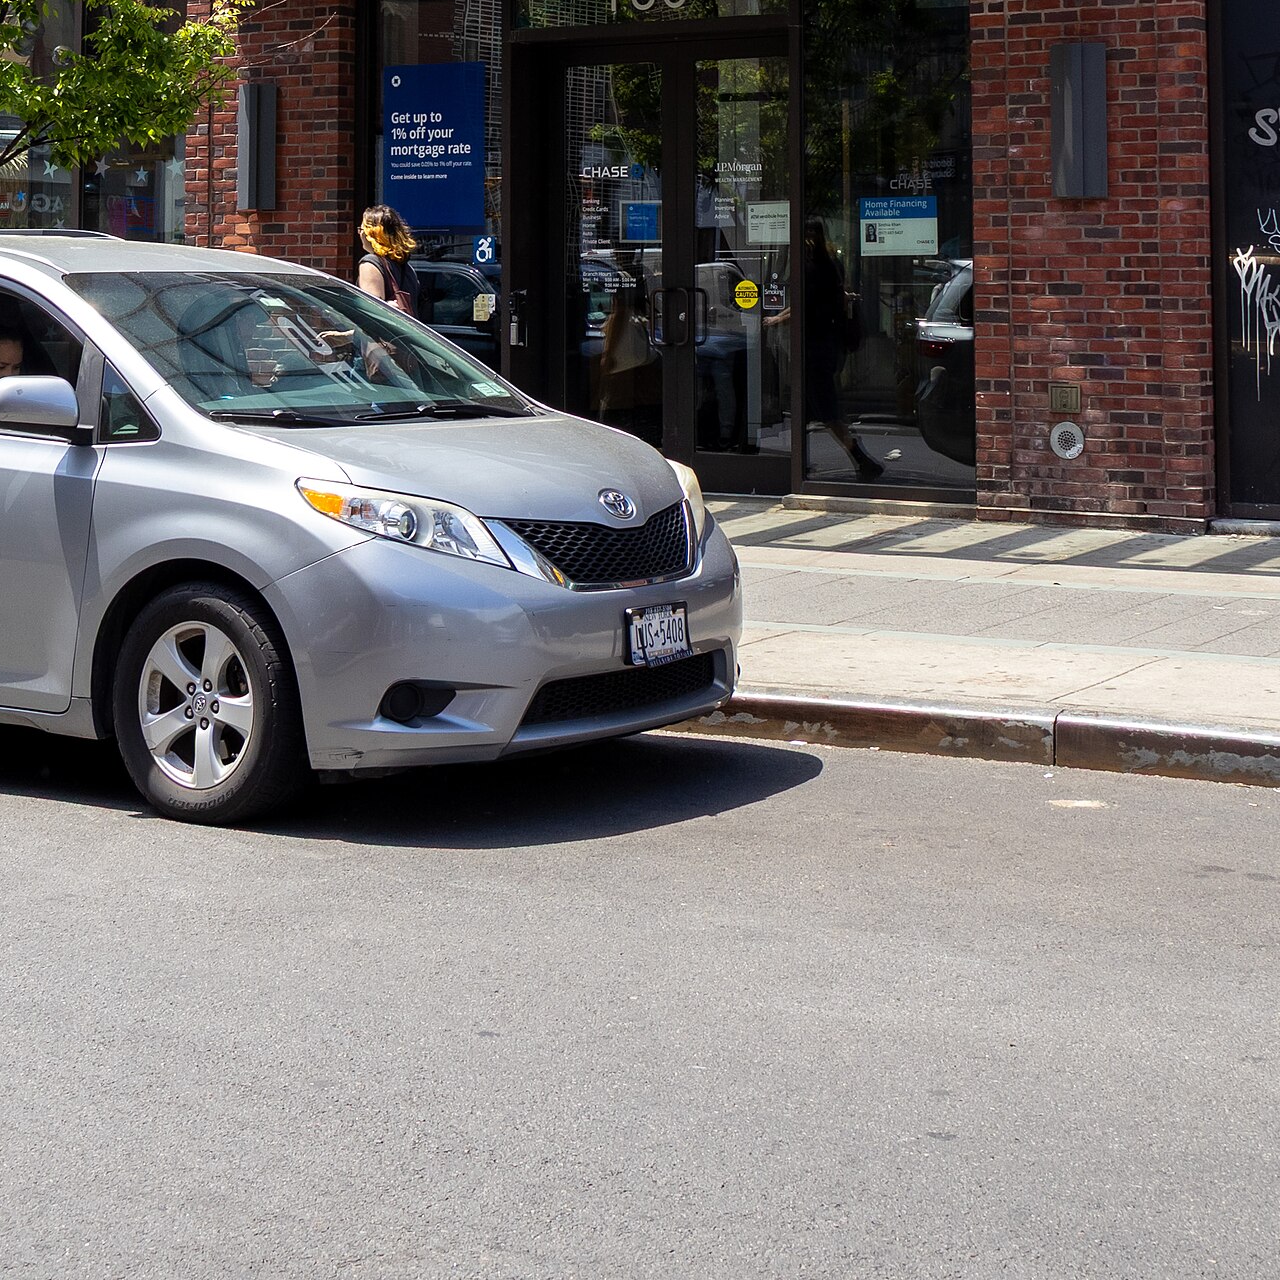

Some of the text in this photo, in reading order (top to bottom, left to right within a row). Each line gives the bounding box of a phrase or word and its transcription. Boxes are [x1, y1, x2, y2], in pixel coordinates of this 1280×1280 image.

[391, 112, 442, 126] Get up to
[391, 126, 454, 142] 1% off your
[391, 143, 471, 158] mortgage rate
[583, 166, 629, 178] CHASE
[890, 180, 932, 189] CHASE
[865, 200, 927, 209] Home Financing
[865, 209, 900, 217] Available
